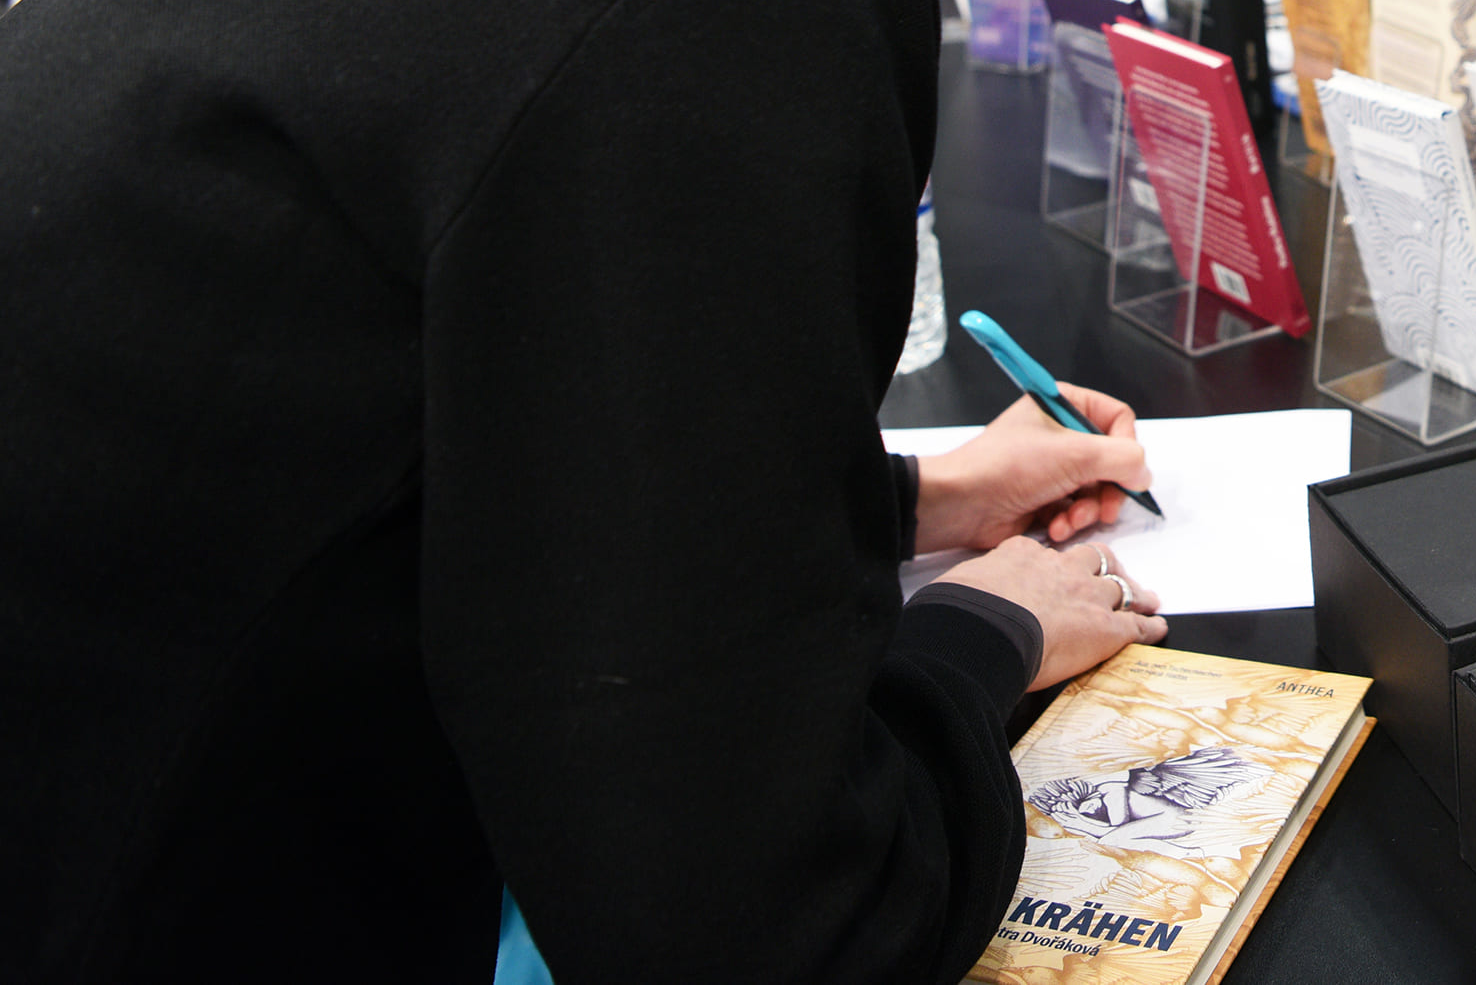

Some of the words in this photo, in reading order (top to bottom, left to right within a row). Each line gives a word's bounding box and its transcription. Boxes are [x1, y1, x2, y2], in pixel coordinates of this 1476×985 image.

[1276, 681, 1334, 698] ANTHEA
[1008, 897, 1184, 951] KRÄHEN
[998, 926, 1018, 940] tra
[1020, 930, 1102, 957] Dvořáková
